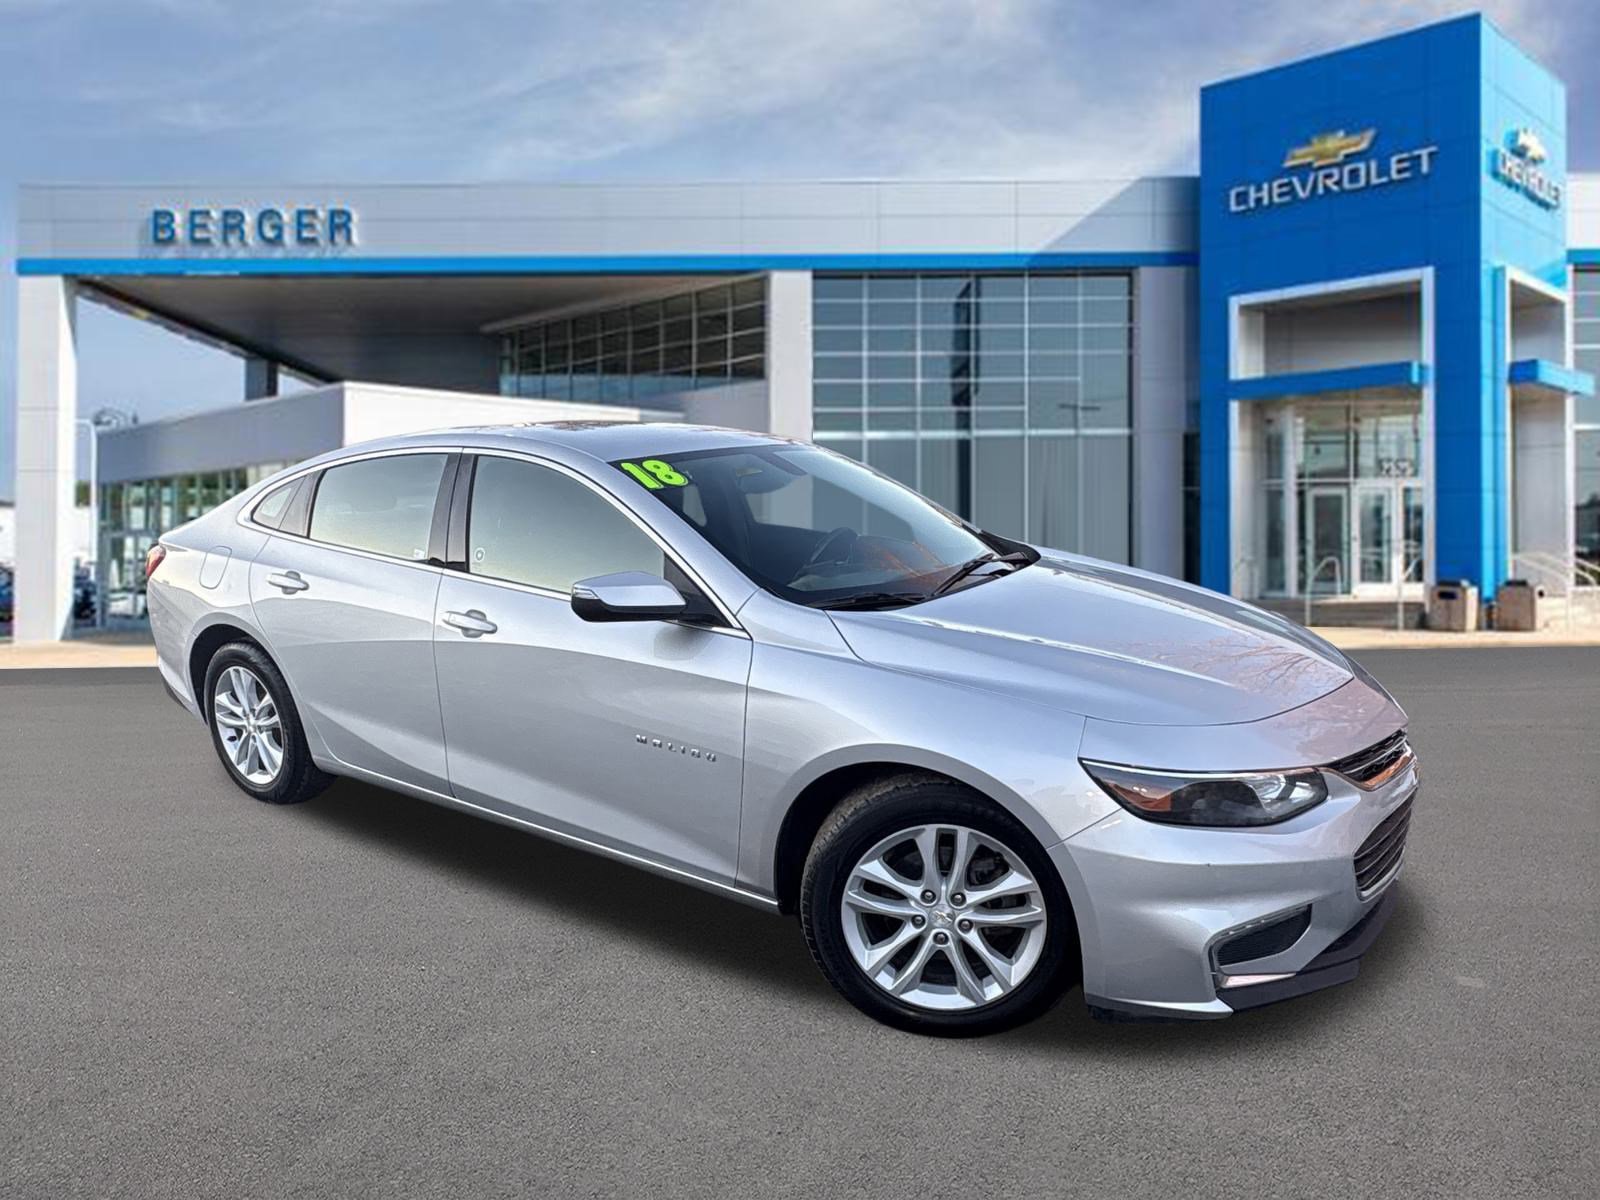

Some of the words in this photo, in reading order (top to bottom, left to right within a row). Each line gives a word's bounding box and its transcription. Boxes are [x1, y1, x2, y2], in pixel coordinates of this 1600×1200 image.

[1229, 146, 1438, 213] CHEVROLET
[152, 207, 355, 246] BERGER
[620, 459, 689, 490] 18
